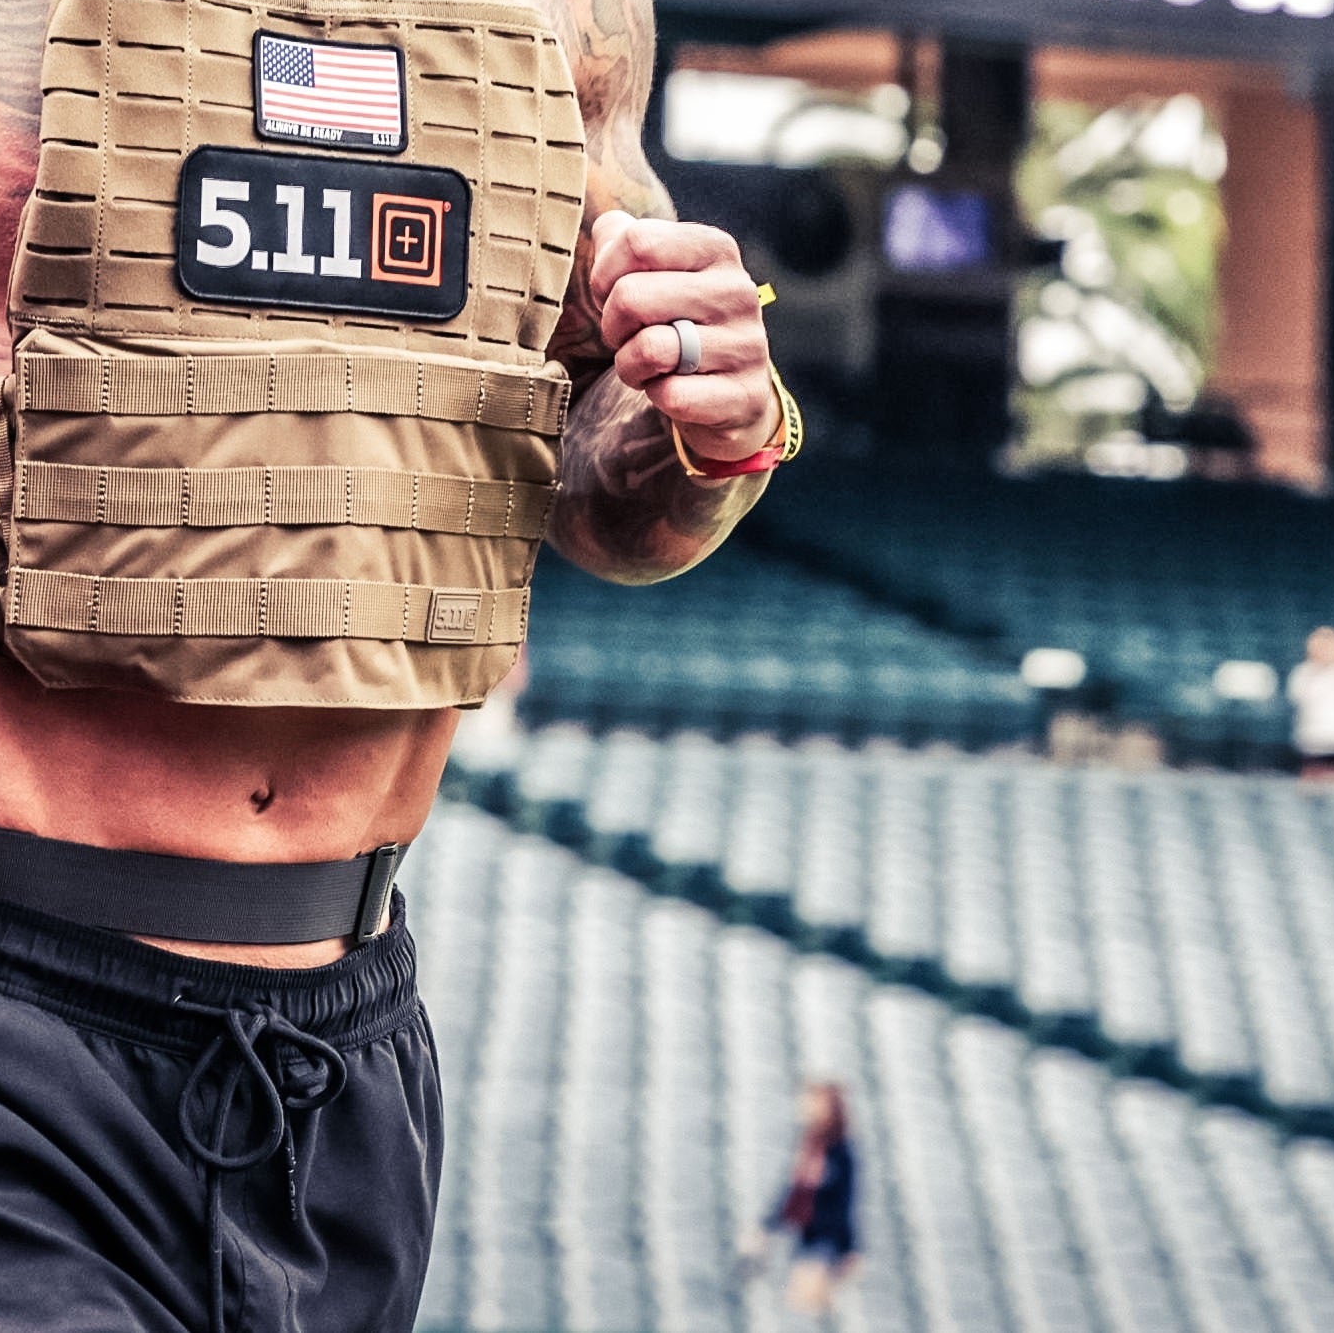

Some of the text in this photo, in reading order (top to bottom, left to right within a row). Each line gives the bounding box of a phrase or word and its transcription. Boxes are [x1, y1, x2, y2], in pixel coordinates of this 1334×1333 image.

[265, 119, 343, 141] ALWAYS BE READY
[196, 177, 362, 279] 5.11
